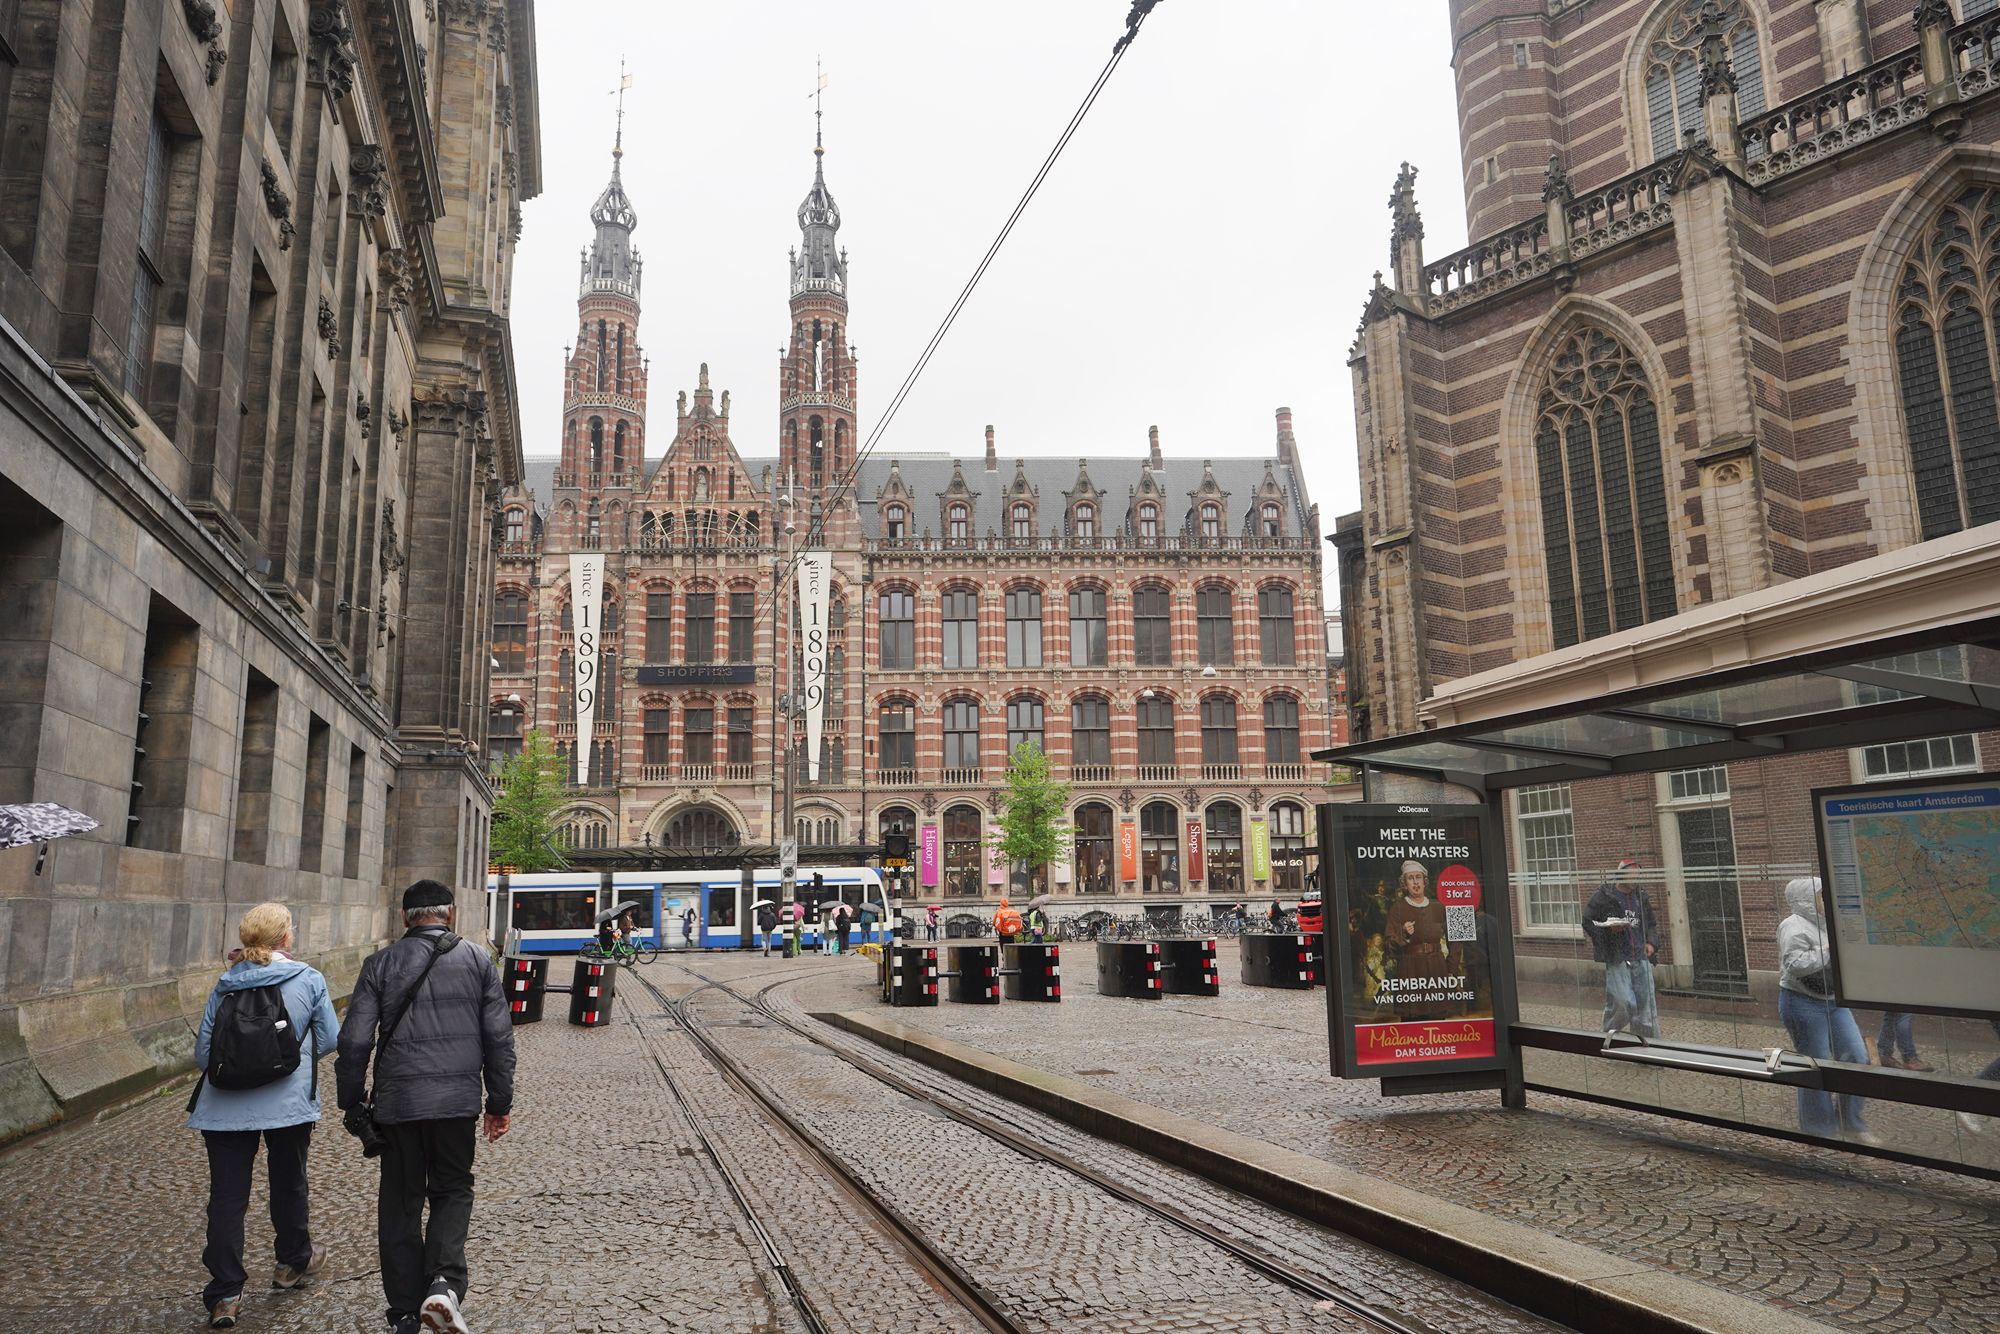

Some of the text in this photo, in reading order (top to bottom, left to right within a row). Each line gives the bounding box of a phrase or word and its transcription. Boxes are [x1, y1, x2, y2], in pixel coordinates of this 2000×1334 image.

[577, 561, 596, 715] since 1899
[807, 560, 823, 711] since 1899
[1838, 795, 1984, 812] Toeristische kaart Amsterdam
[1122, 826, 1135, 861] Legacy
[1189, 825, 1202, 854] Shops
[1380, 828, 1446, 841] MEET THE
[924, 830, 936, 866] History
[1255, 825, 1266, 872] Memories
[1357, 846, 1469, 859] DUTCH MASTERS
[1446, 890, 1472, 898] 3 for 2!
[1381, 976, 1466, 991] REMBRANDT
[1374, 991, 1475, 1004] VAN GOGH AND MORE
[1369, 1024, 1481, 1048] Madame Tussauds
[1395, 1046, 1457, 1057] DAM SQUARE
